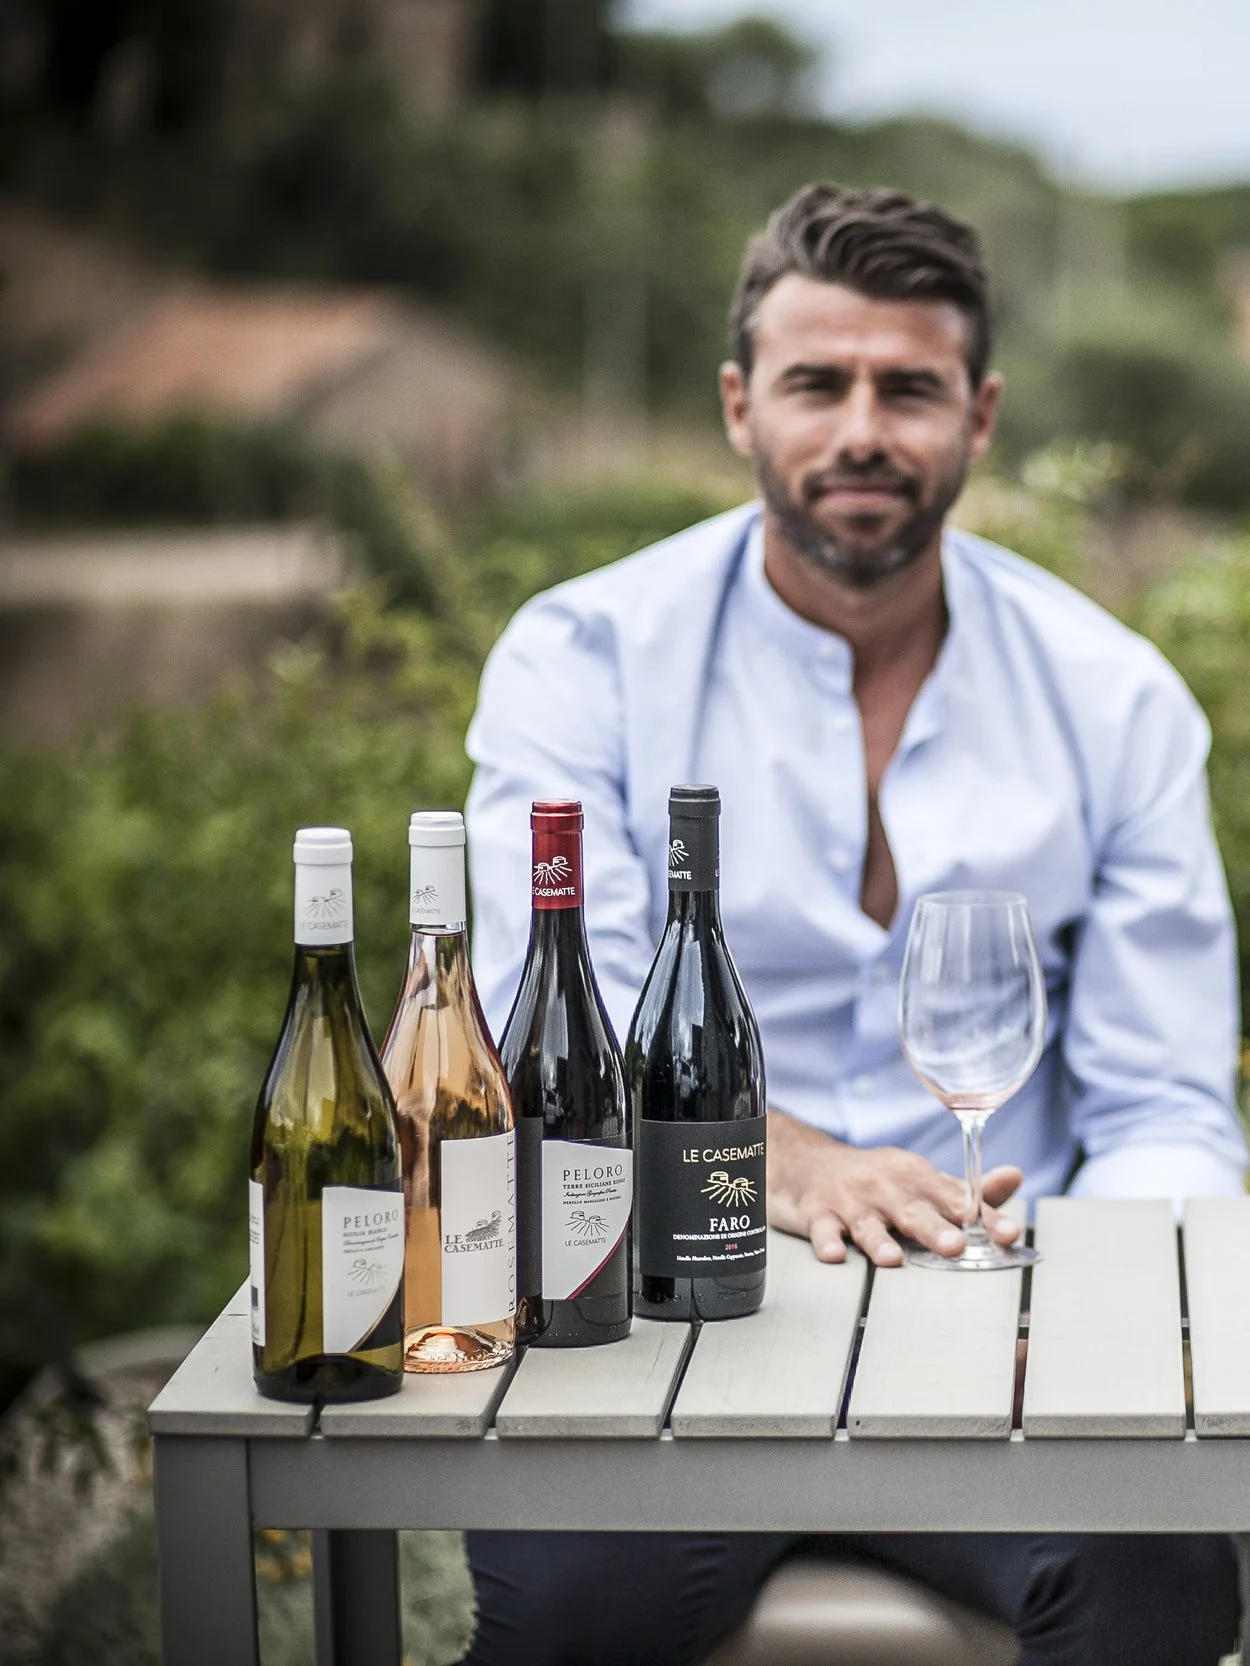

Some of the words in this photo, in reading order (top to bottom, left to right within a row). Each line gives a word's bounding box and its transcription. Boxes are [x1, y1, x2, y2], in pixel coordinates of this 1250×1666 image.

[535, 886, 576, 897] CASEMATTE
[683, 1149, 699, 1163] LE
[702, 1142, 764, 1163] CASEMATTE
[563, 1163, 623, 1181] PELORO
[585, 1180, 612, 1189] SICILIANE
[343, 1209, 399, 1229] PELORO
[507, 1133, 516, 1313] ROSEMATTE
[709, 1215, 751, 1232] FARO
[444, 1234, 463, 1245] LE
[444, 1239, 504, 1254] CASEMATTE
[565, 1239, 572, 1247] LE
[573, 1237, 606, 1247] CASEMATTE
